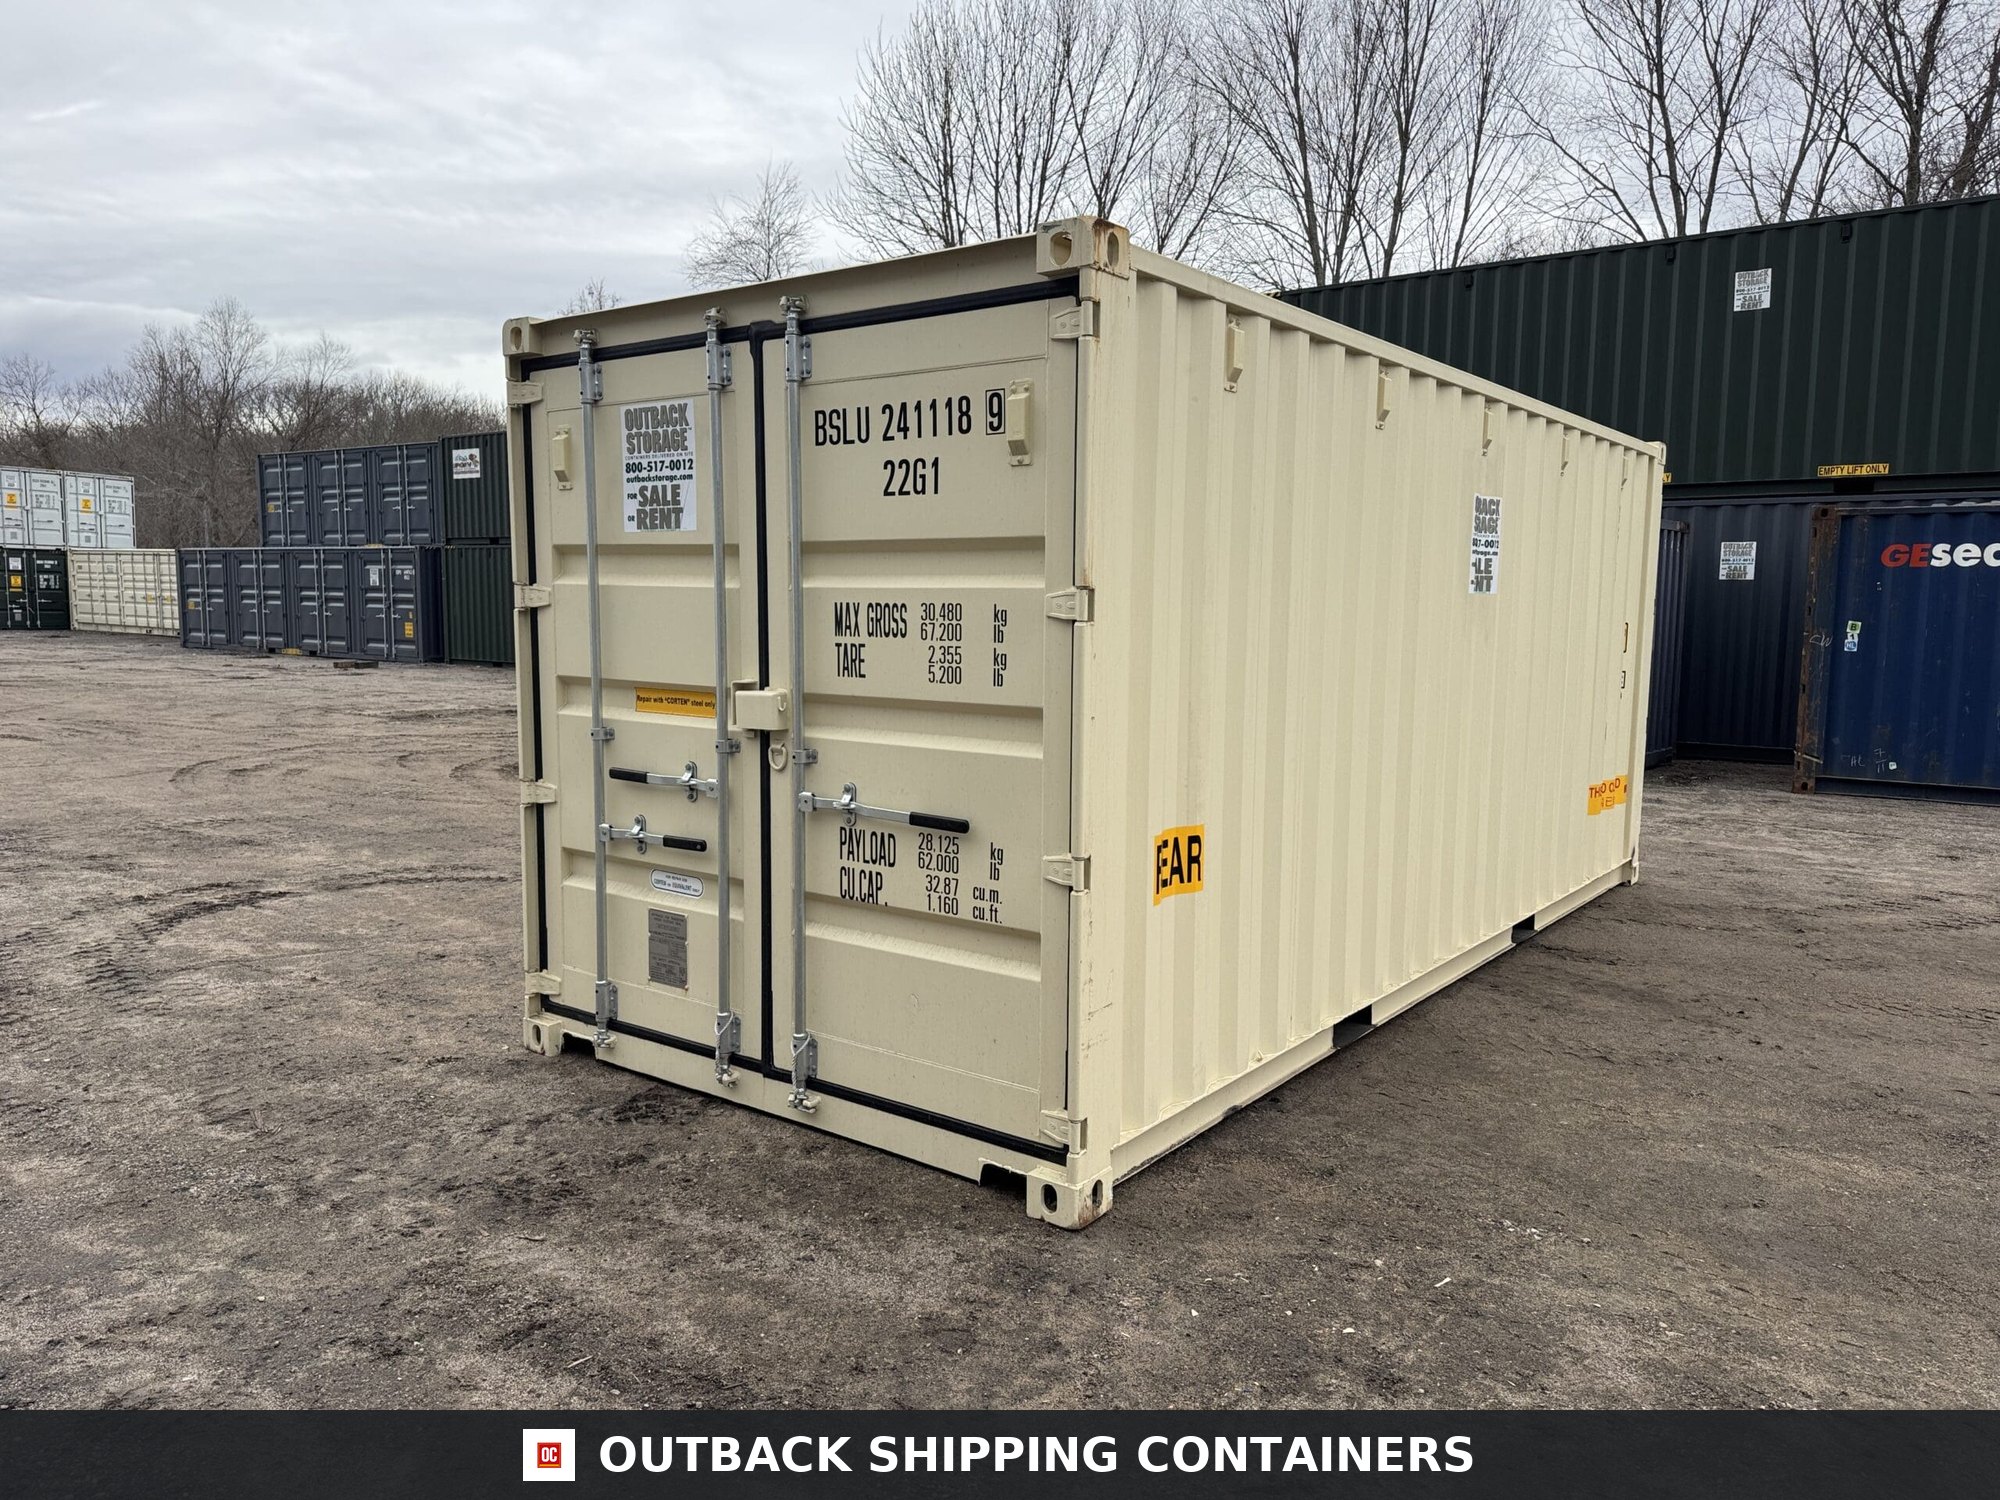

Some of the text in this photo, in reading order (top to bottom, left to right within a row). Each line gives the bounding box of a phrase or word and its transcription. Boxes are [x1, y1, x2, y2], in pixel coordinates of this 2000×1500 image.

[624, 403, 689, 431] OUTBACK
[814, 391, 1004, 447] BSLU 241118 9
[626, 428, 688, 455] STORAGE
[625, 458, 693, 474] 800-517-0012
[626, 473, 693, 483] outbackstorage.com
[883, 457, 940, 497] 22G1
[1818, 464, 1888, 476] EMPTY LIFT ONLY
[638, 483, 681, 508] SALE
[636, 507, 684, 530] RENT
[834, 602, 860, 637] MAX
[866, 602, 908, 639] GROSS
[993, 603, 1007, 627] kg
[993, 624, 1004, 643] lb
[835, 643, 866, 678] TARE
[993, 647, 1007, 671] kg
[993, 667, 1004, 687] lb
[637, 694, 652, 703] Repair
[705, 701, 715, 709] only
[839, 826, 896, 867] PAYLOAD
[990, 842, 1004, 865] kg
[989, 861, 1000, 881] lb
[925, 874, 959, 896] 32.87
[972, 886, 1002, 904] cu.m.
[972, 904, 1002, 924] cu.ft.
